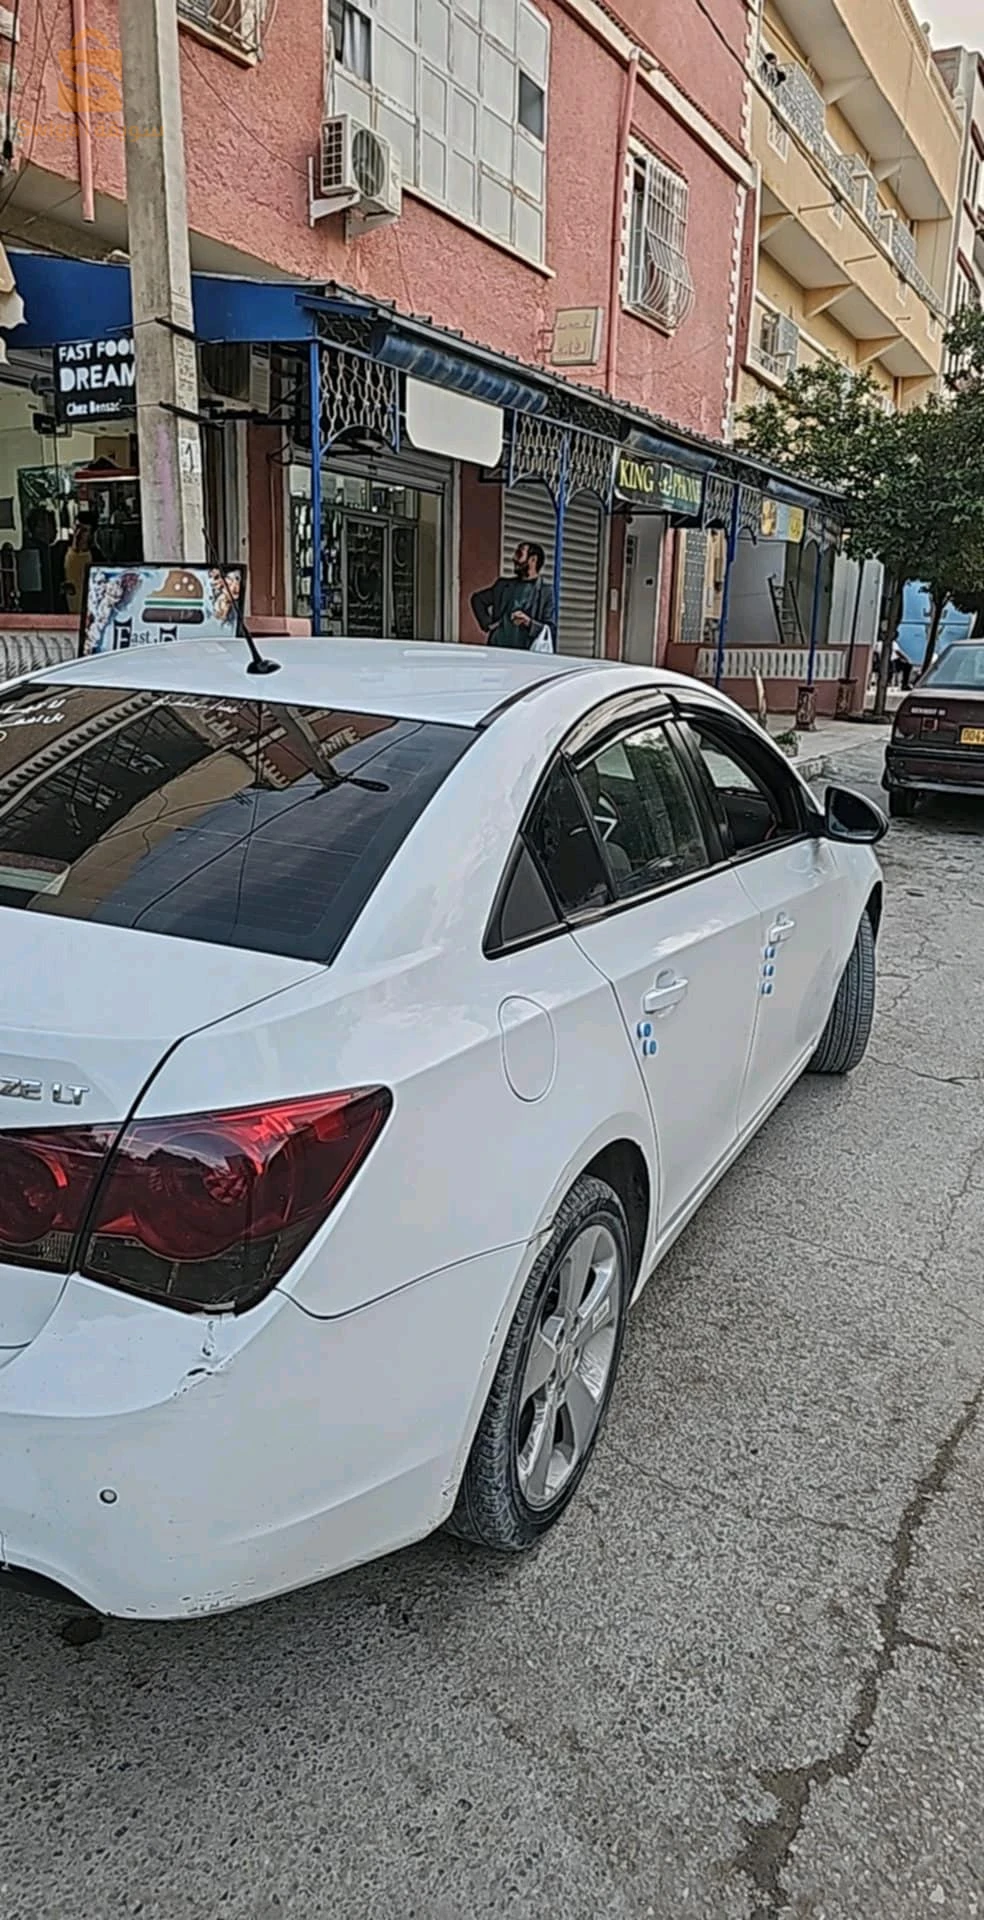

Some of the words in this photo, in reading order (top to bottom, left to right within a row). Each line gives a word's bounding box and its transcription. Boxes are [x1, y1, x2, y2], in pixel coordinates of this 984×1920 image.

[58, 343, 93, 362] FAST
[66, 401, 88, 416] Chez
[619, 459, 654, 494] KING
[52, 1083, 90, 1106] LT
